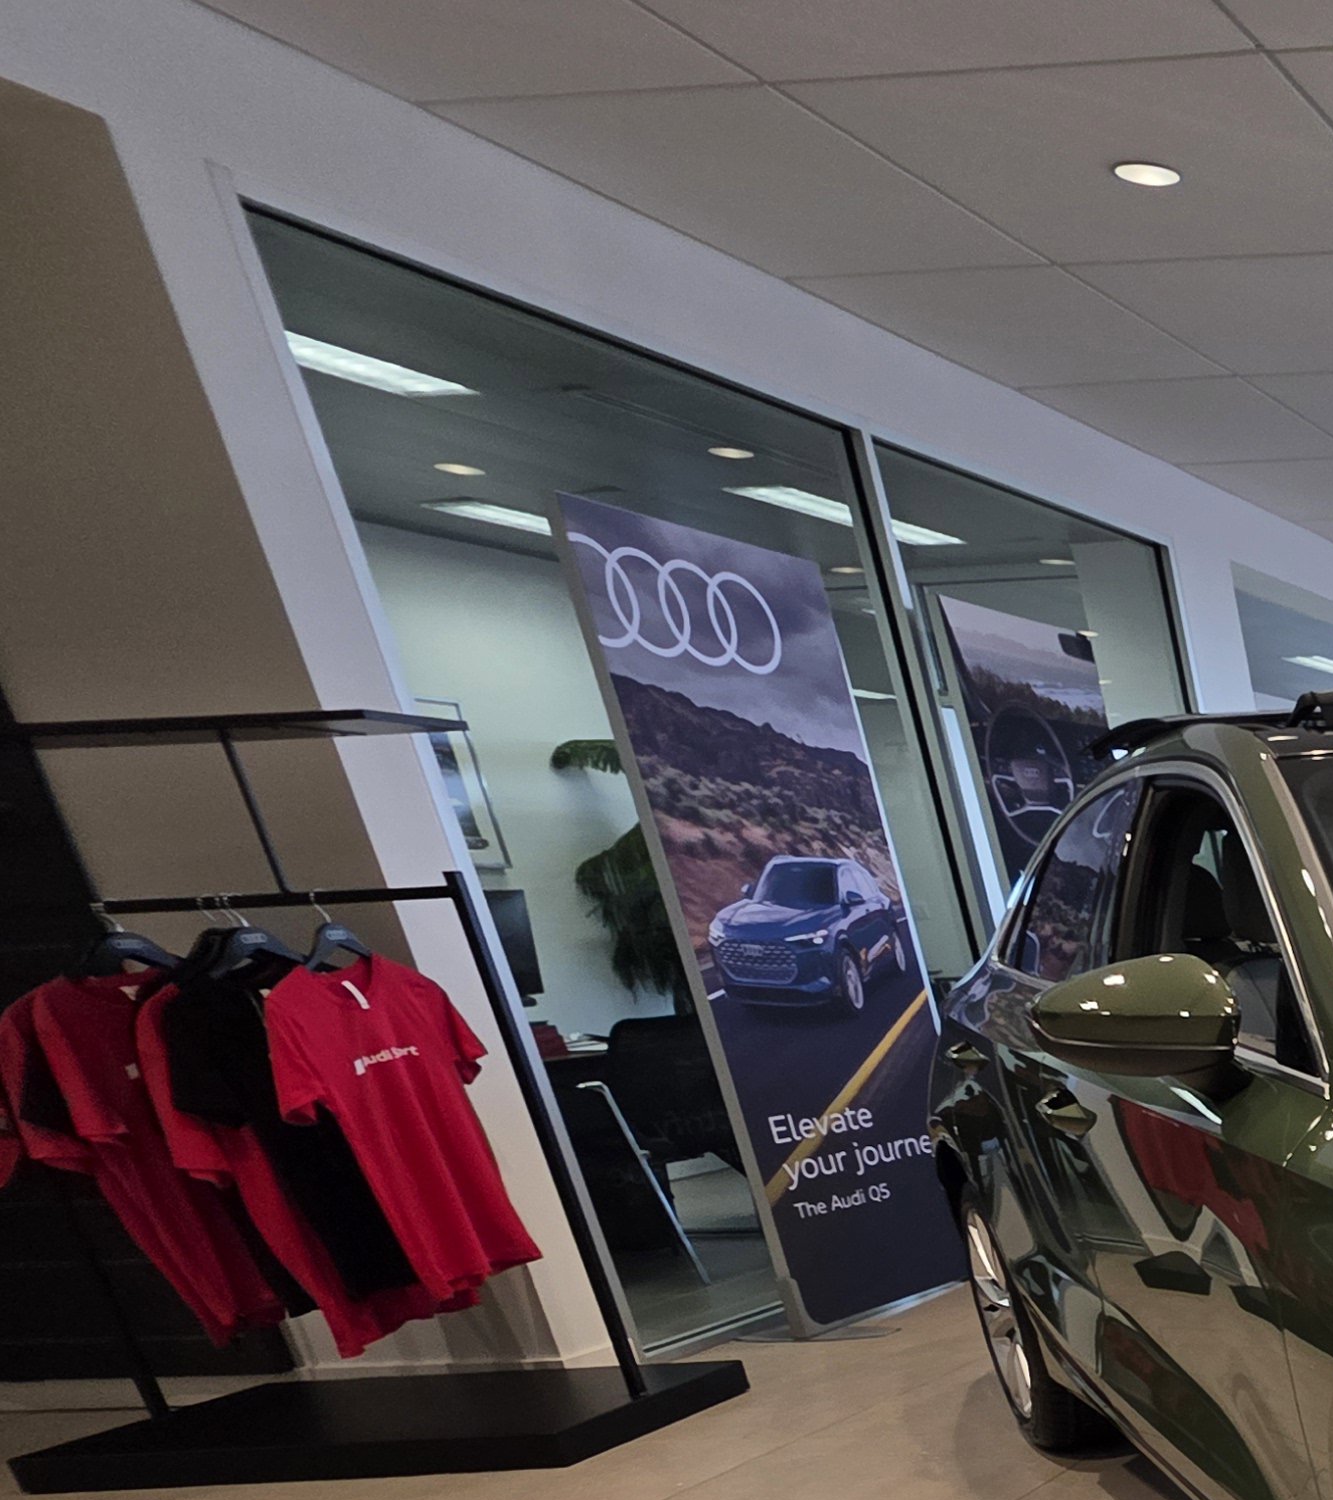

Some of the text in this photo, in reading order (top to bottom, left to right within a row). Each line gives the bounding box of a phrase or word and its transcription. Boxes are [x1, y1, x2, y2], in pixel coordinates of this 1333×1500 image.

[768, 1107, 873, 1144] Elevate
[782, 1133, 935, 1190] your journe
[793, 1182, 891, 1219] The Audi Q5
